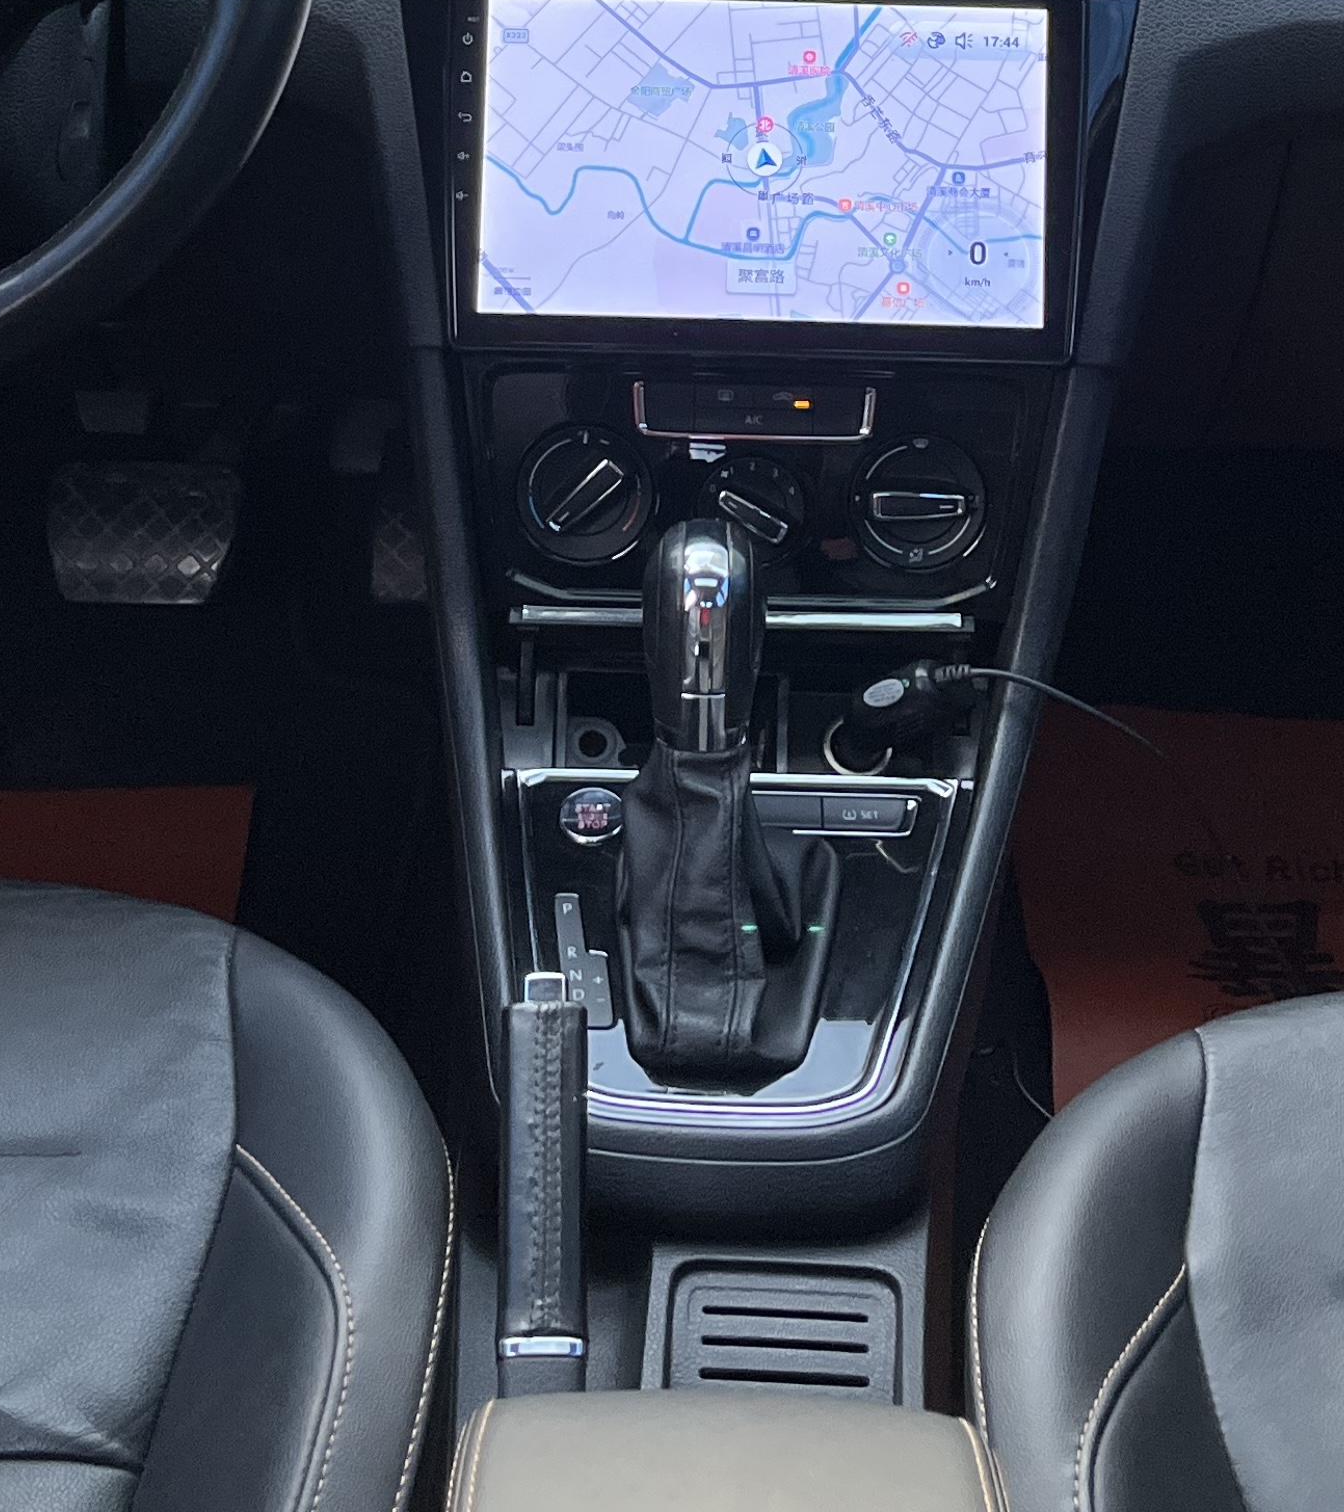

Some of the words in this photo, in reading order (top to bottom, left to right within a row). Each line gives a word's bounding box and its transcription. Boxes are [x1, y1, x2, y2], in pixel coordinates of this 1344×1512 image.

[982, 35, 1020, 49] 17:44
[968, 240, 987, 266] 0
[736, 267, 785, 284] 聚富路
[964, 276, 991, 288] km/h
[574, 803, 612, 813] START
[860, 809, 879, 820] SET
[578, 820, 608, 829] STOP
[562, 902, 573, 915] P
[567, 946, 578, 959] R
[569, 969, 583, 982] N
[572, 988, 585, 1001] D
